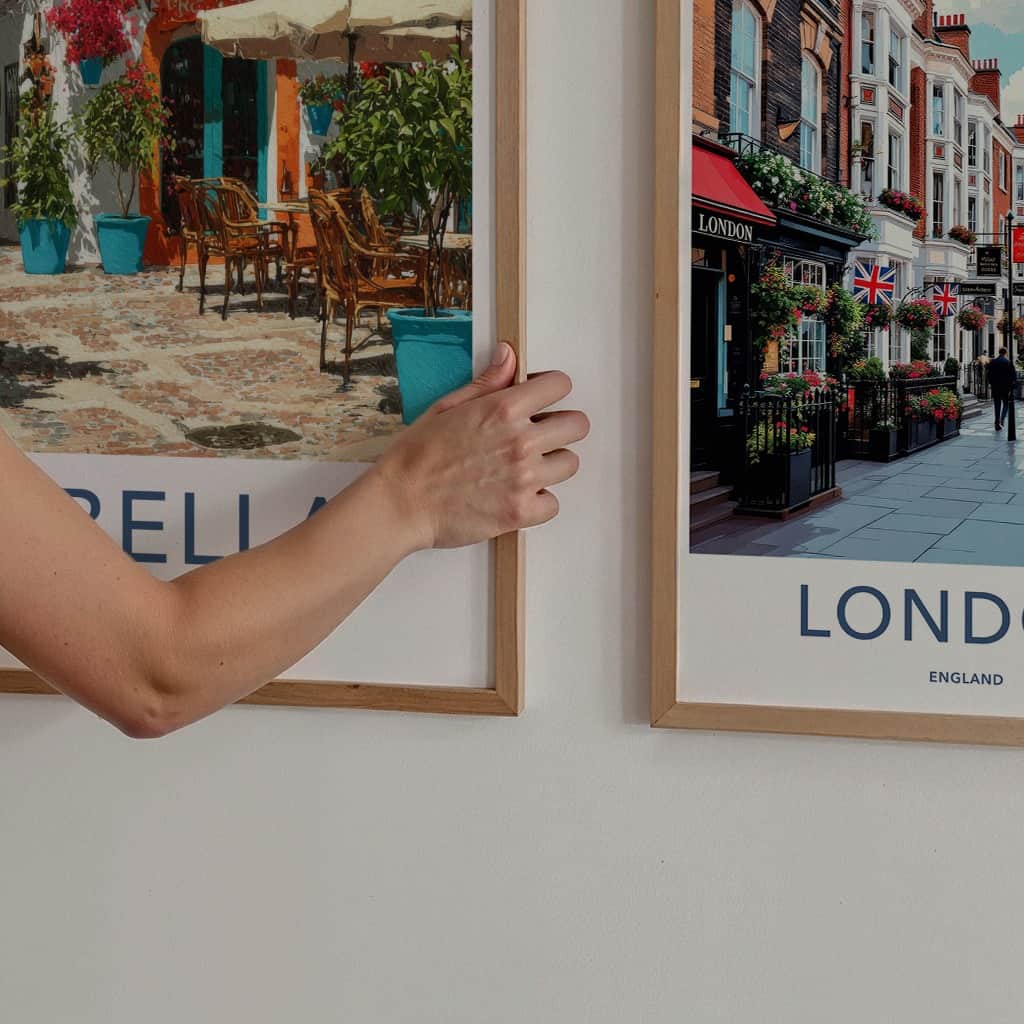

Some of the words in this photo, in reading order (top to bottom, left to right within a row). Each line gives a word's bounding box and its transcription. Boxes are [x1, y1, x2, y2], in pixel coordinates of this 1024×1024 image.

[698, 213, 753, 242] LONDON
[63, 487, 328, 565] ELL
[800, 583, 1024, 644] LOND
[928, 671, 1004, 686] ENGLAND
